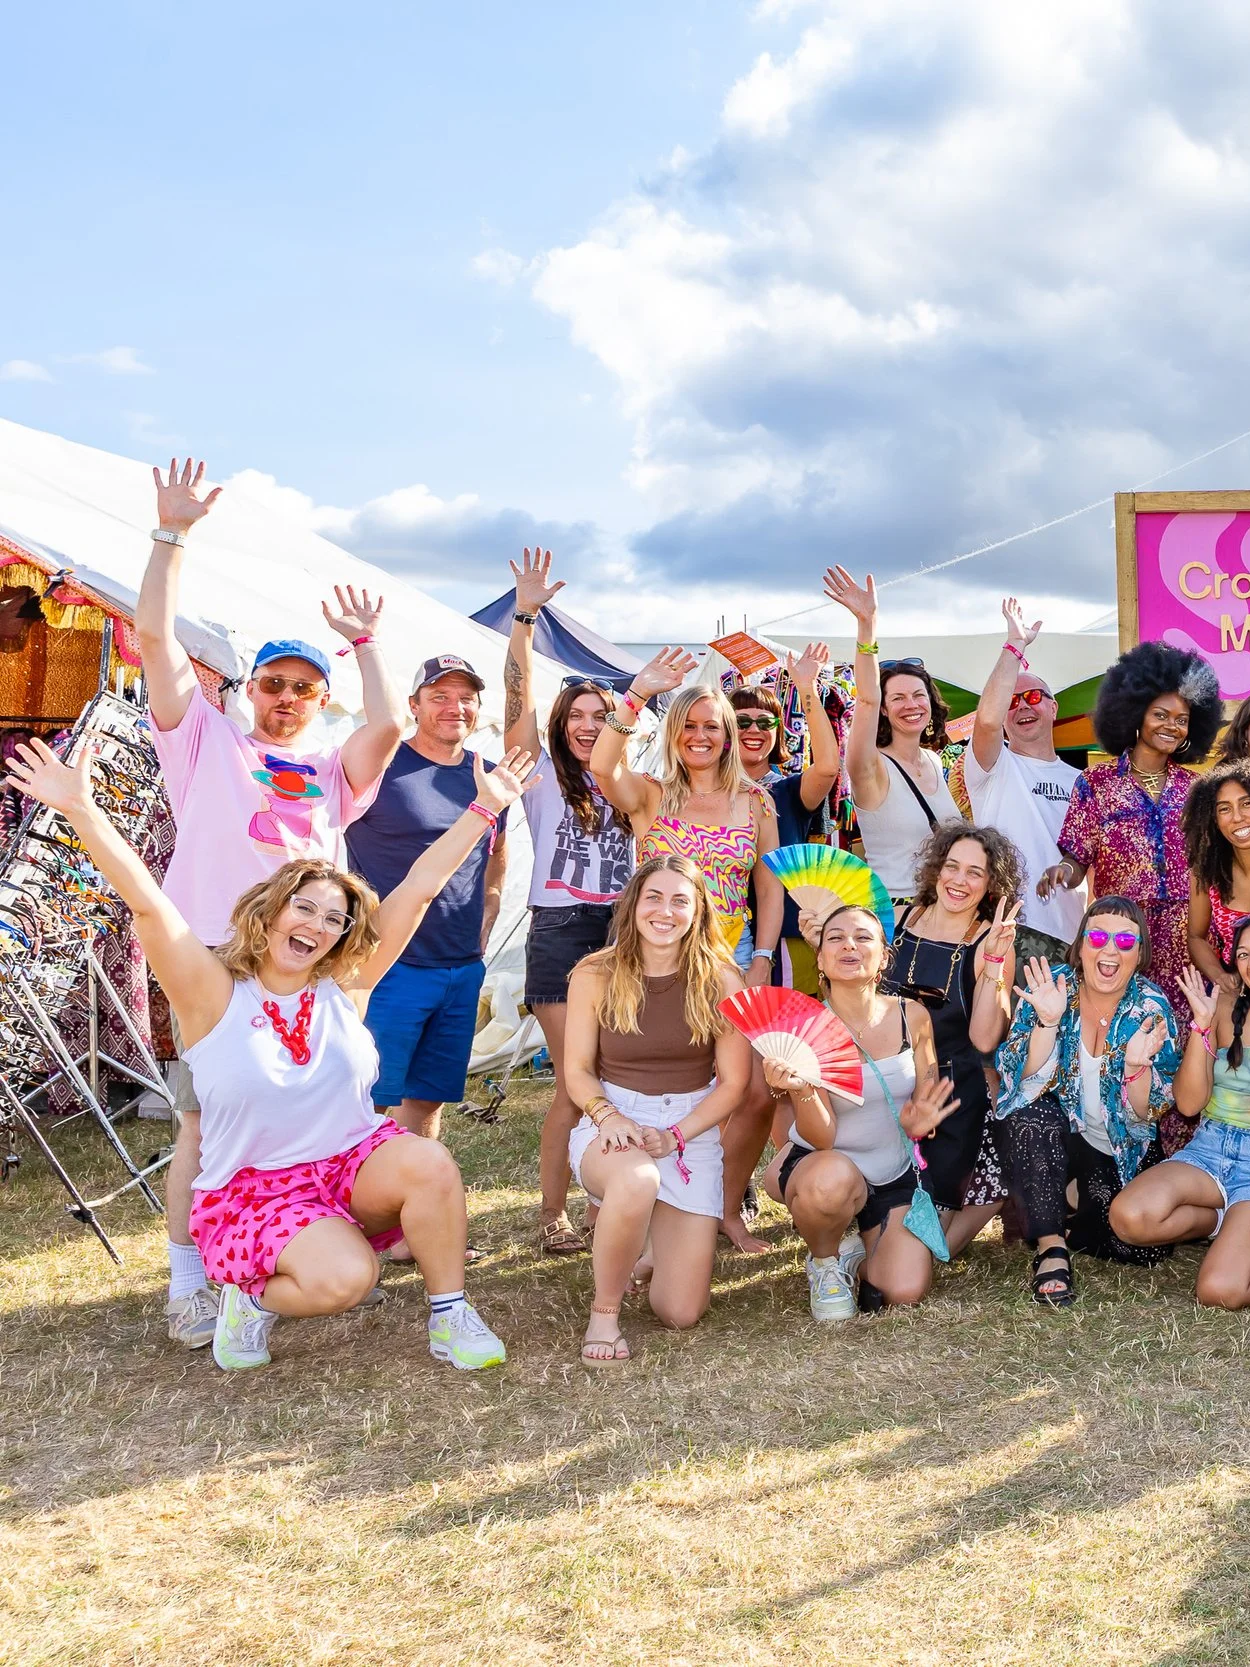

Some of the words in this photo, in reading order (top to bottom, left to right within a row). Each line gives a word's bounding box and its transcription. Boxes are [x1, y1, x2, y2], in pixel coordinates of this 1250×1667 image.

[555, 830, 590, 852] THE
[598, 843, 631, 866] WA
[550, 848, 590, 889] IT
[599, 859, 632, 894] IS
